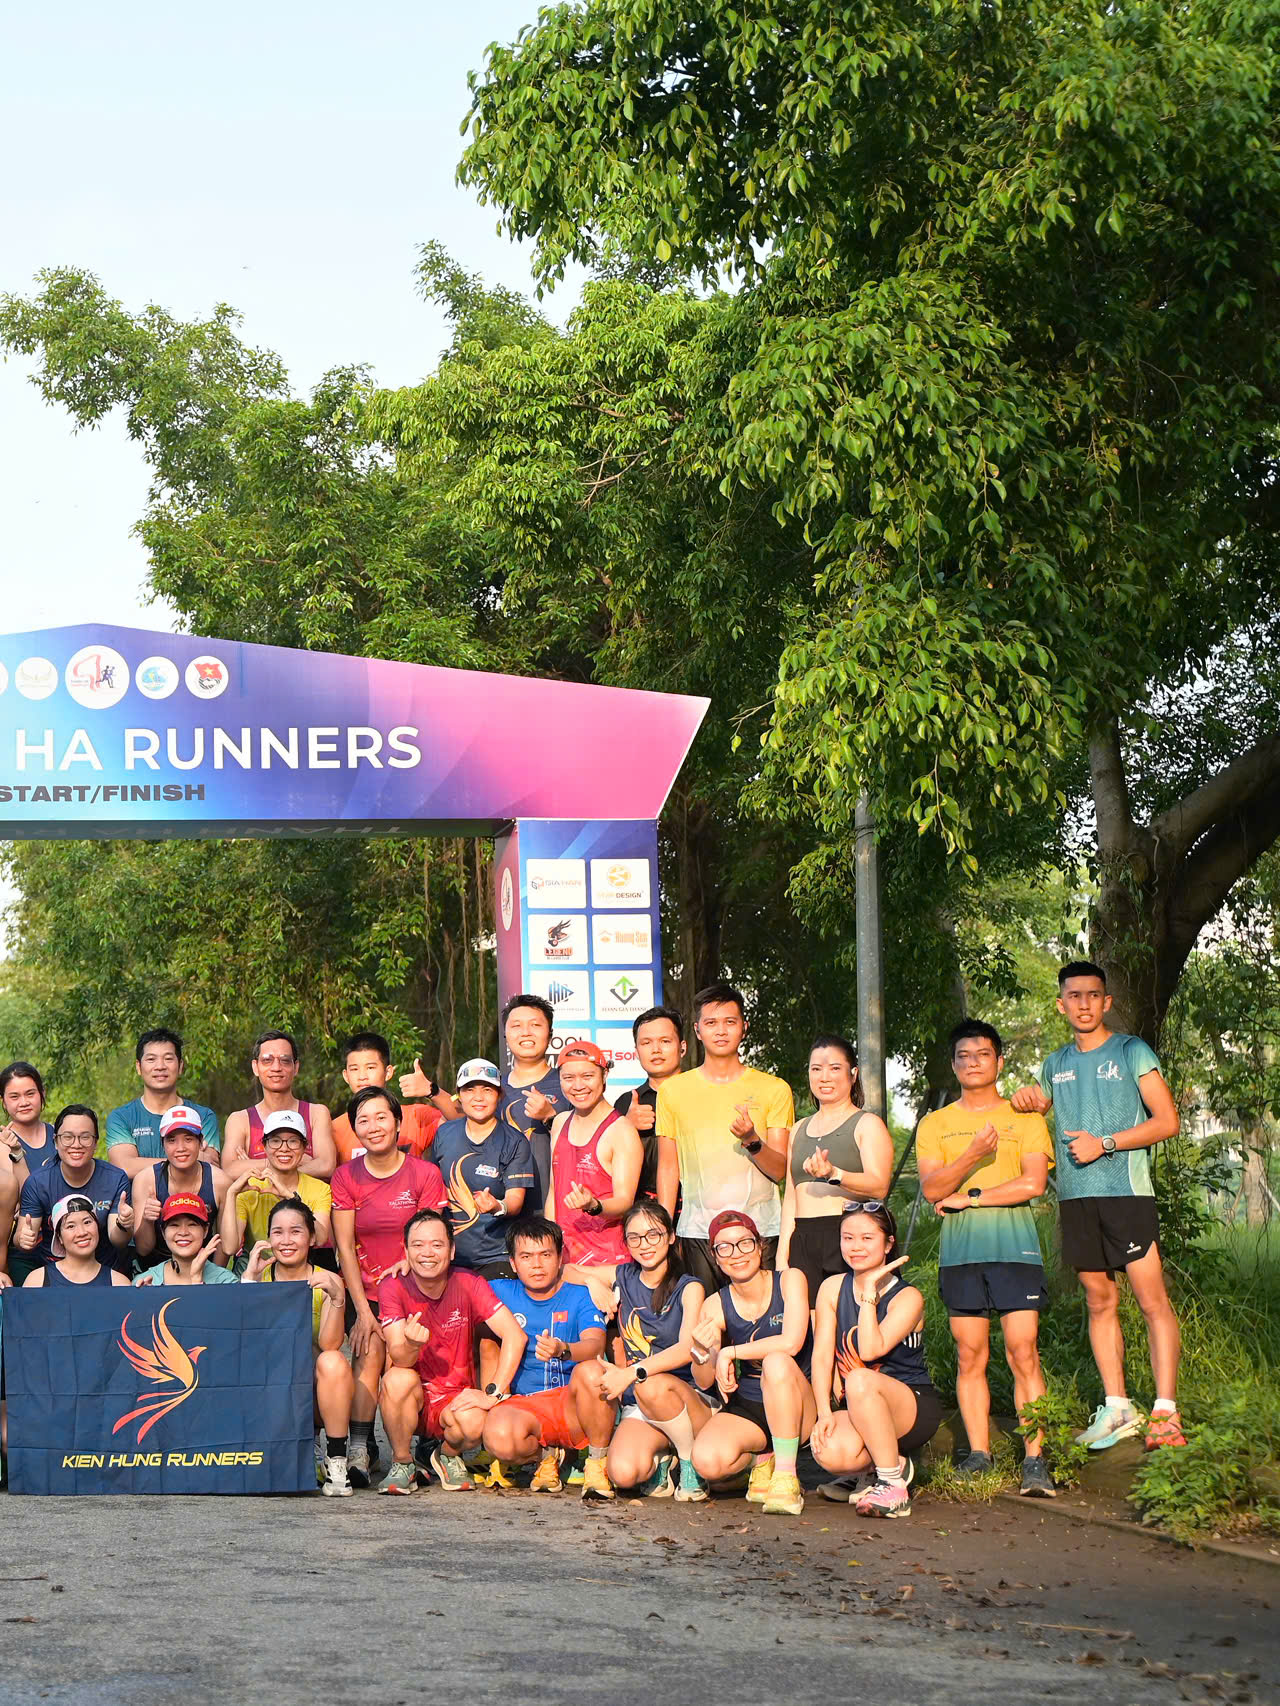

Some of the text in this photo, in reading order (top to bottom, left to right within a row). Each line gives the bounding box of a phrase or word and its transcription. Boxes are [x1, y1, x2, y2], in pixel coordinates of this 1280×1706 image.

[15, 729, 104, 771] HA
[125, 726, 422, 770] RUNNERS
[169, 1198, 200, 1208] adidas
[62, 1451, 265, 1468] KIEN HUNG RUNNERS
